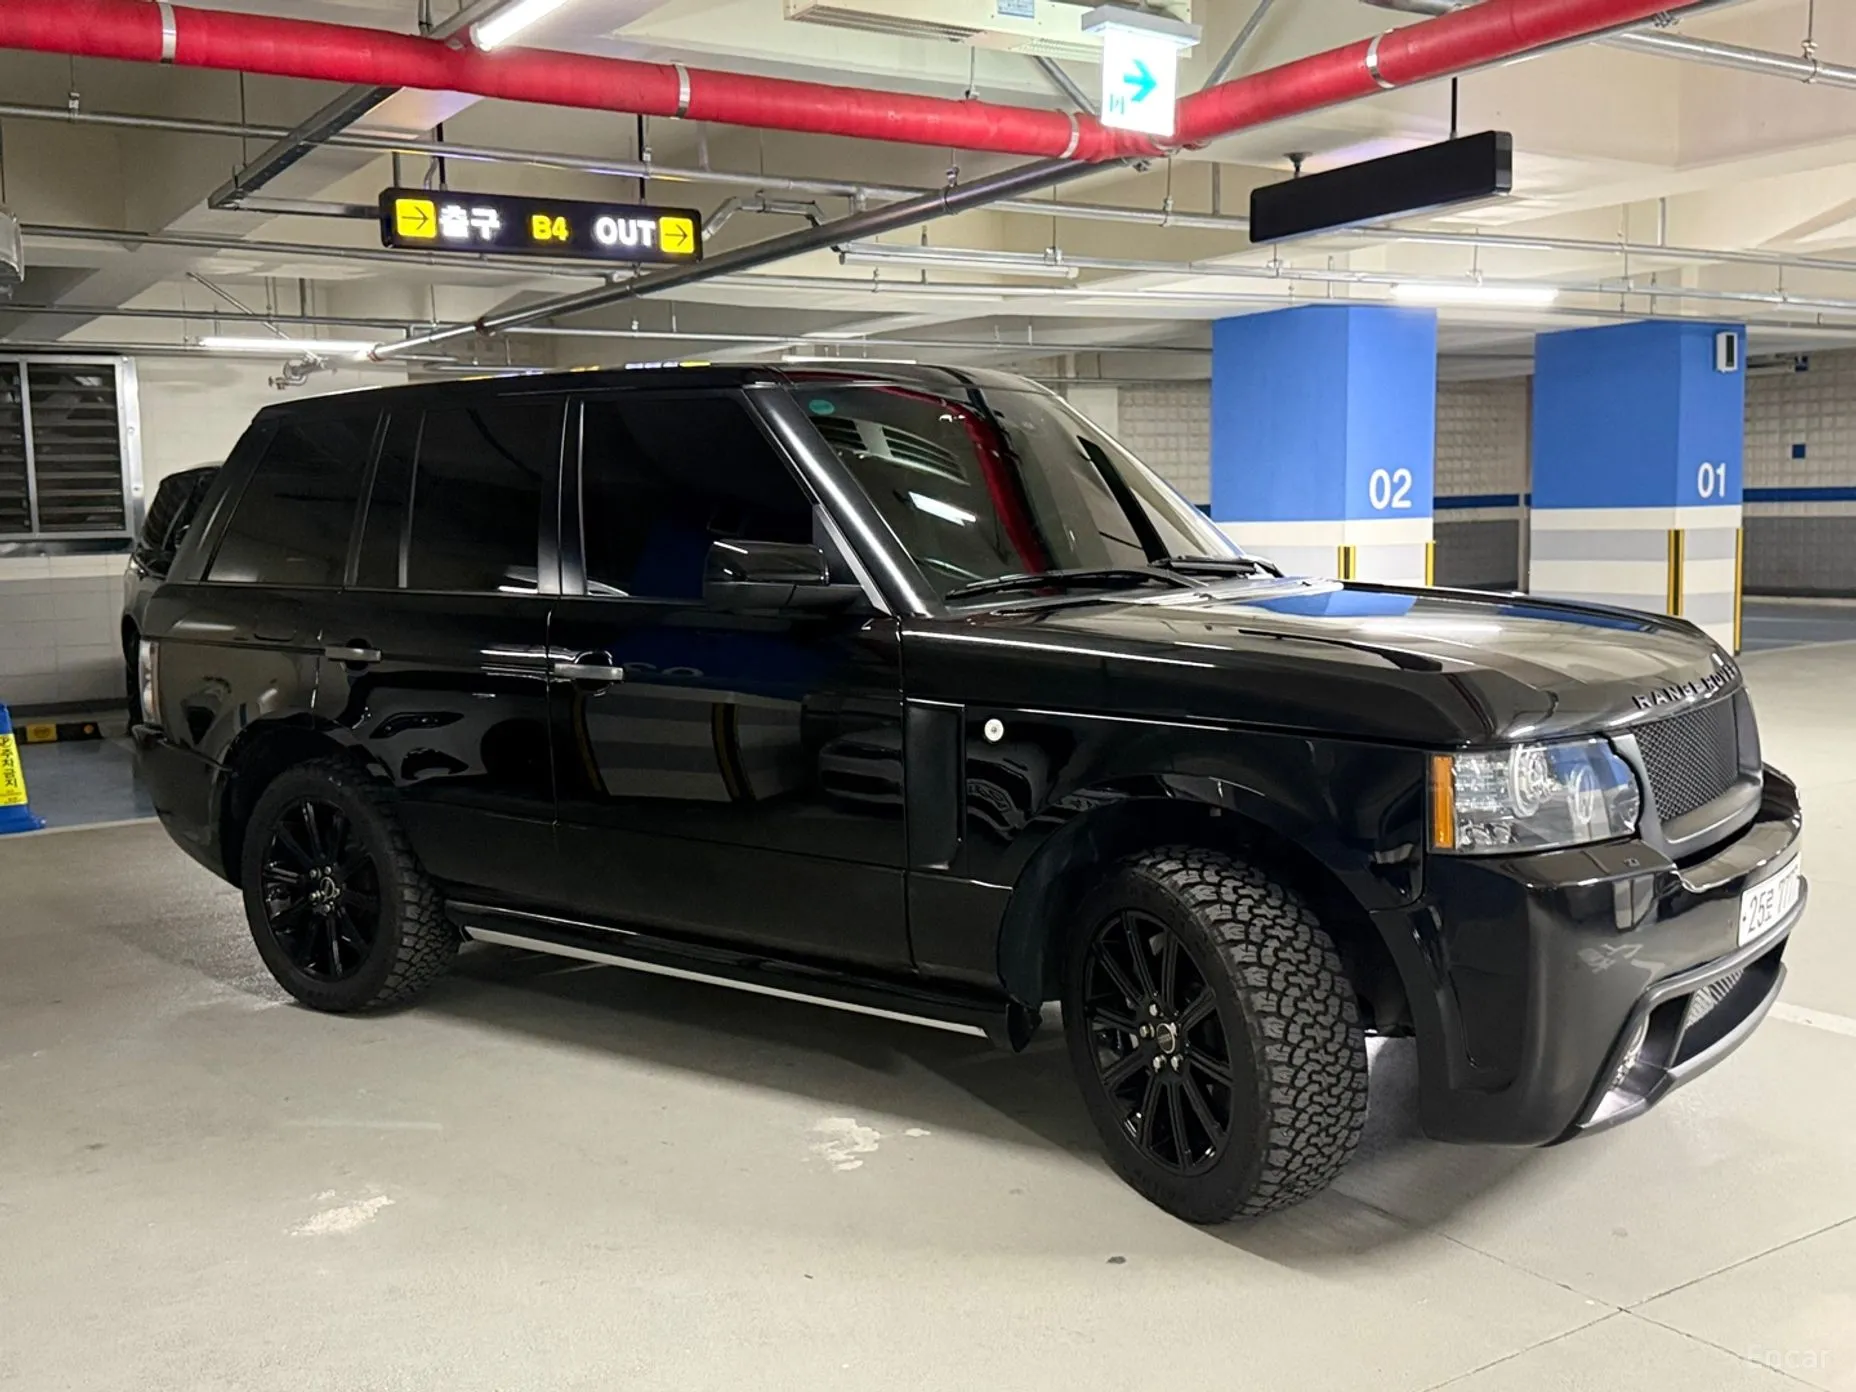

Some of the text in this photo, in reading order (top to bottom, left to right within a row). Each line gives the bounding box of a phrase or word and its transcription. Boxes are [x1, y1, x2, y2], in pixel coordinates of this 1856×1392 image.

[440, 205, 656, 246] 출구 B4 OUT
[1368, 468, 1412, 510] 02
[1697, 462, 1726, 498] 01
